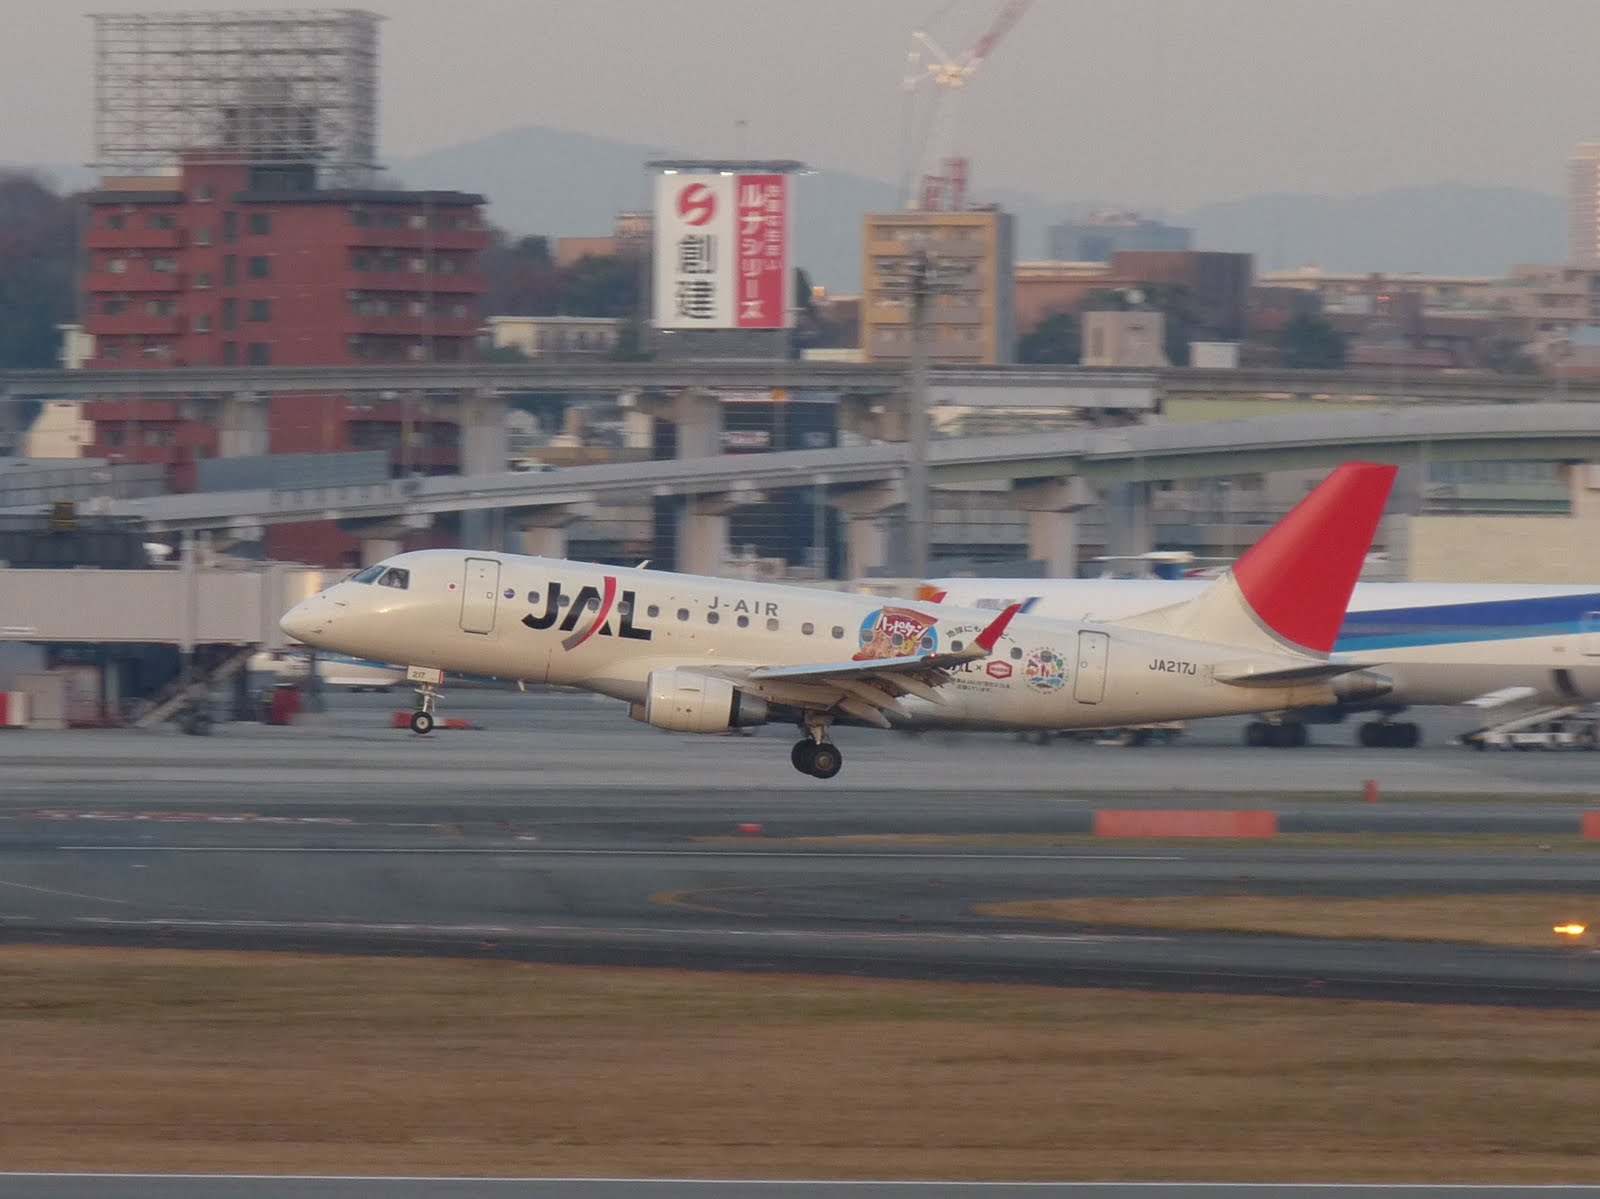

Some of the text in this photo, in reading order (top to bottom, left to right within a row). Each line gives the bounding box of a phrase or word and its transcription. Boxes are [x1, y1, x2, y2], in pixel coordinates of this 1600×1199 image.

[676, 234, 717, 319] 創建
[521, 576, 652, 651] JAL
[708, 596, 778, 616] J-AIR
[1149, 659, 1197, 675] JA217J
